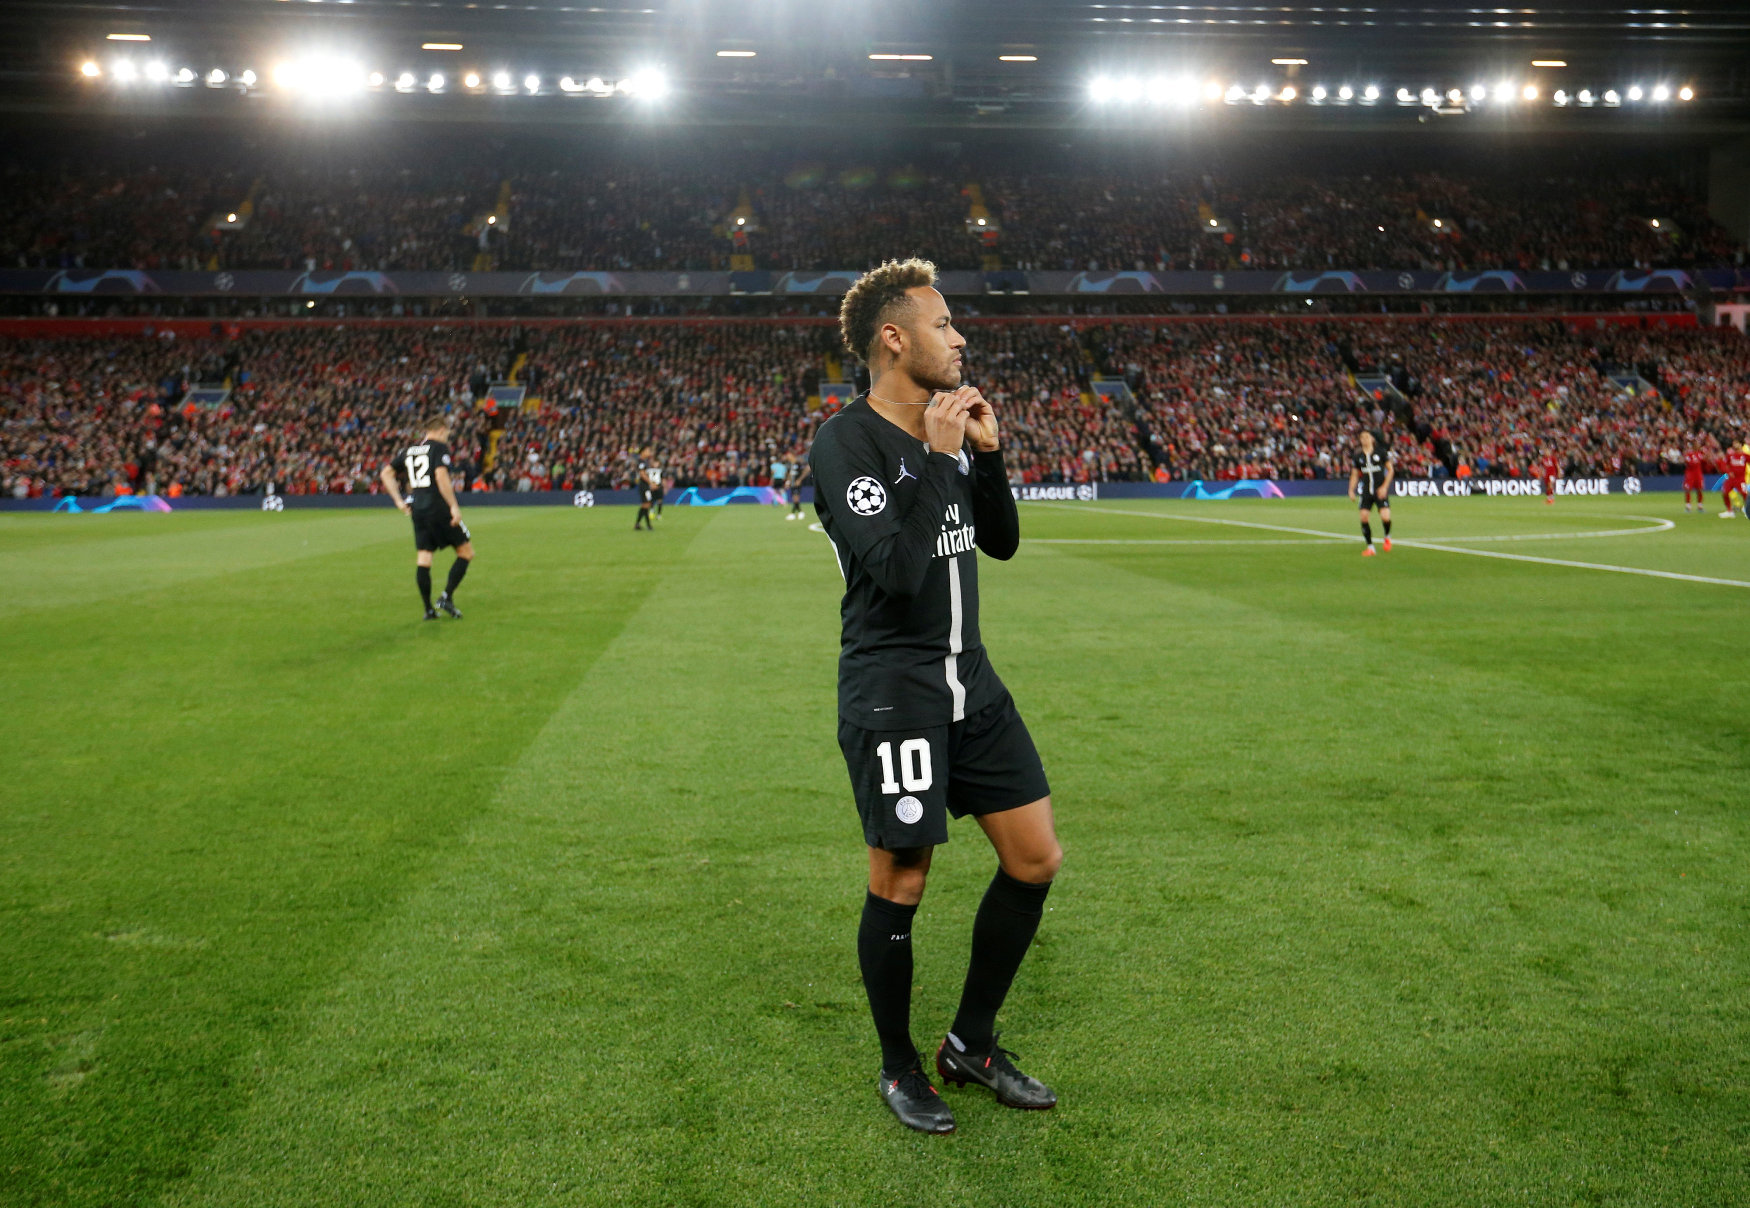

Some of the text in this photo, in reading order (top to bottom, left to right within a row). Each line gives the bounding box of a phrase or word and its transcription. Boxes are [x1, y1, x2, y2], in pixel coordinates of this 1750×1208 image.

[404, 454, 431, 488] 12
[1022, 486, 1075, 501] LEAGUE
[1394, 480, 1440, 497] UEFA
[1554, 478, 1610, 496] EAGUE
[876, 737, 933, 795] 10
